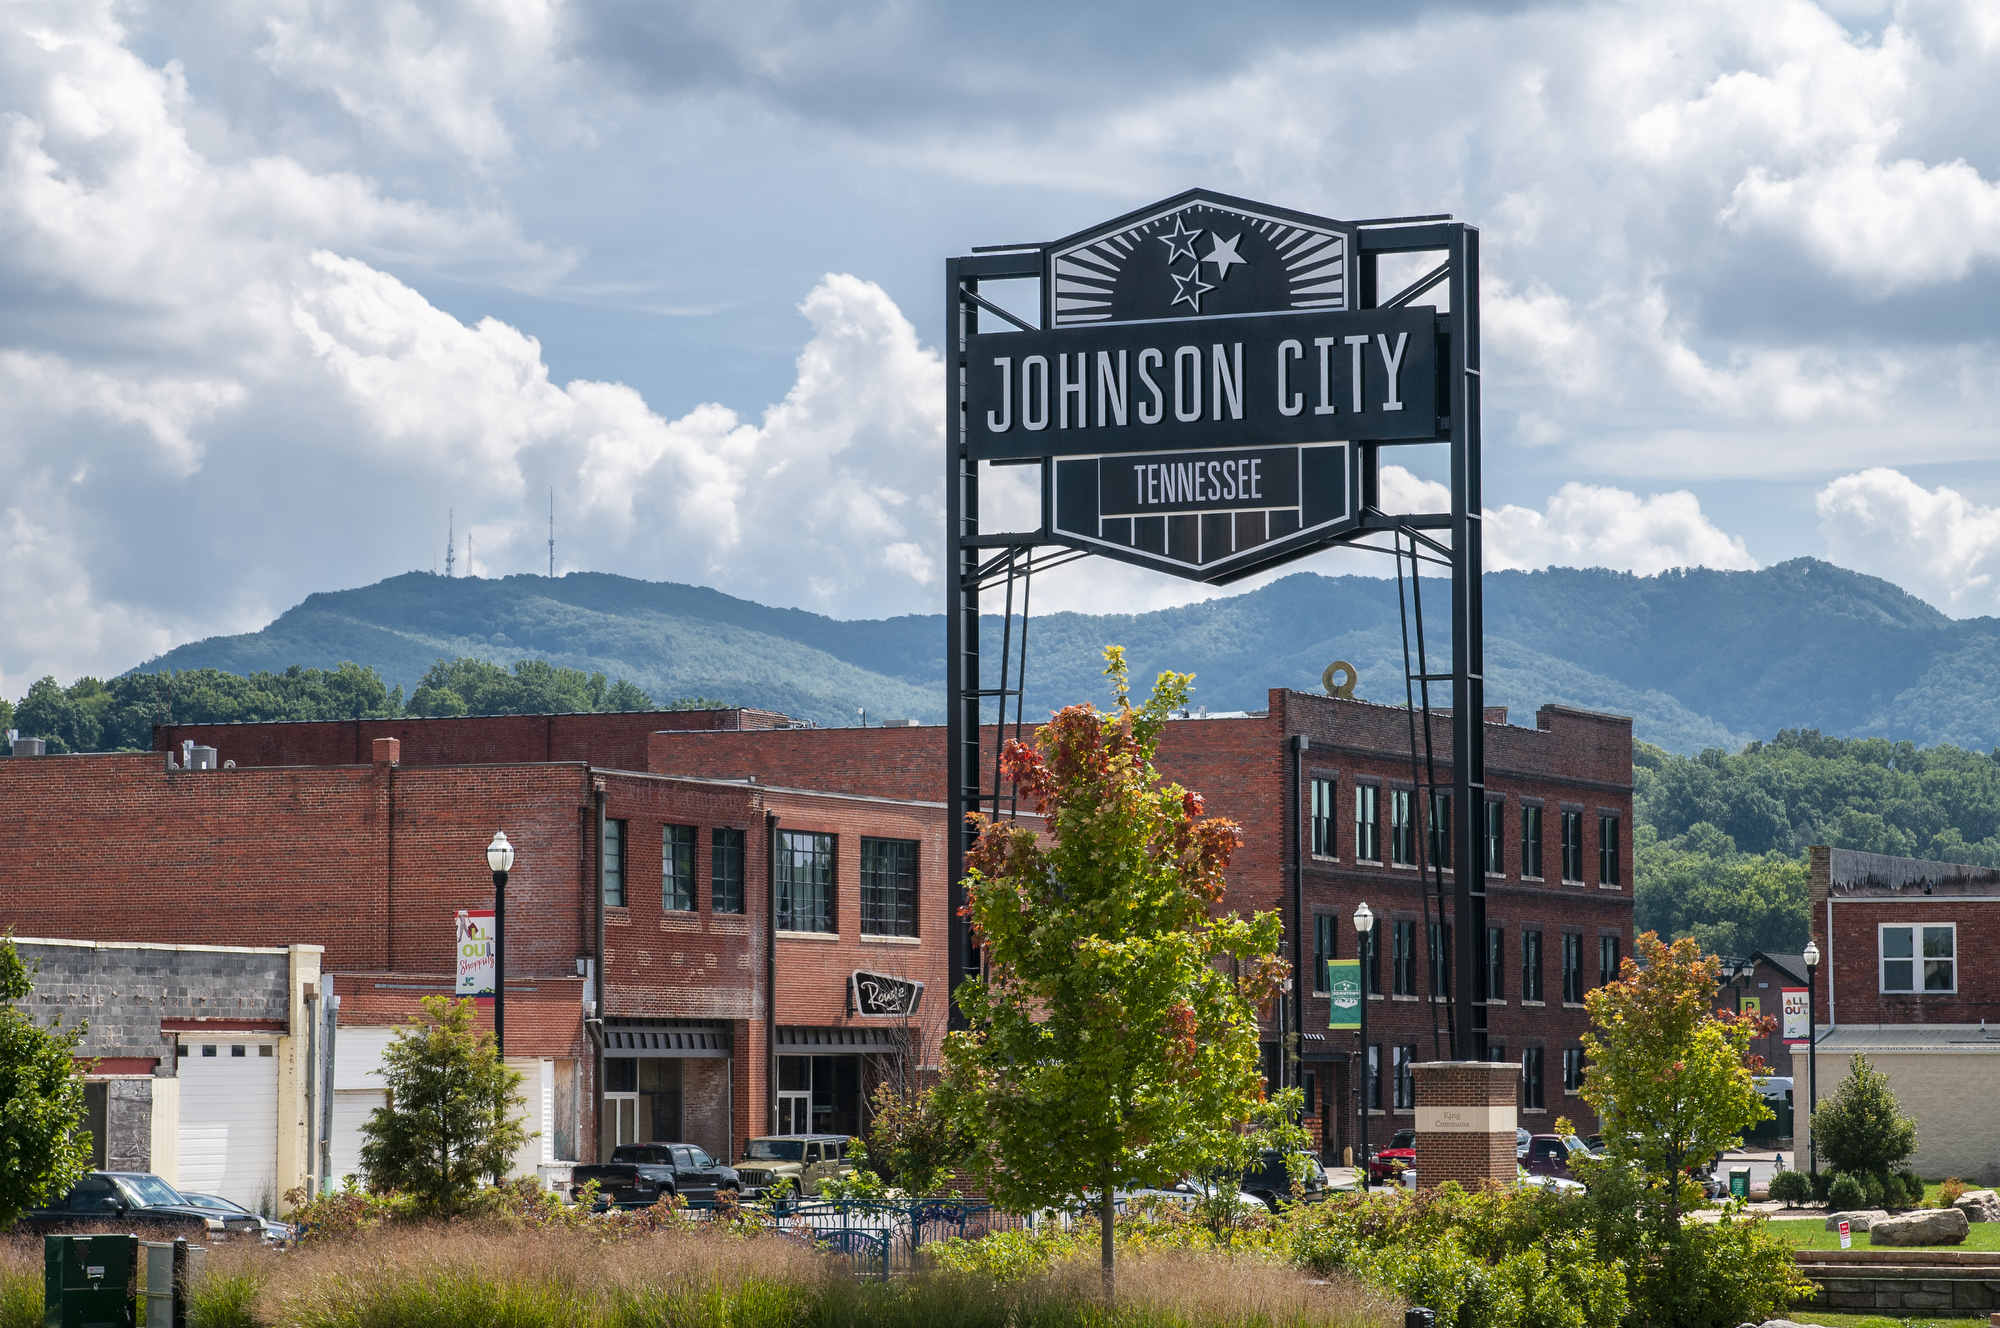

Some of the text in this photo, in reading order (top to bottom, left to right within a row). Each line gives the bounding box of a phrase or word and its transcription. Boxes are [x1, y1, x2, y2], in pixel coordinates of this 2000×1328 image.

[986, 331, 1409, 434] JOHNSON CITY
[1133, 457, 1263, 506] TENNESSEE
